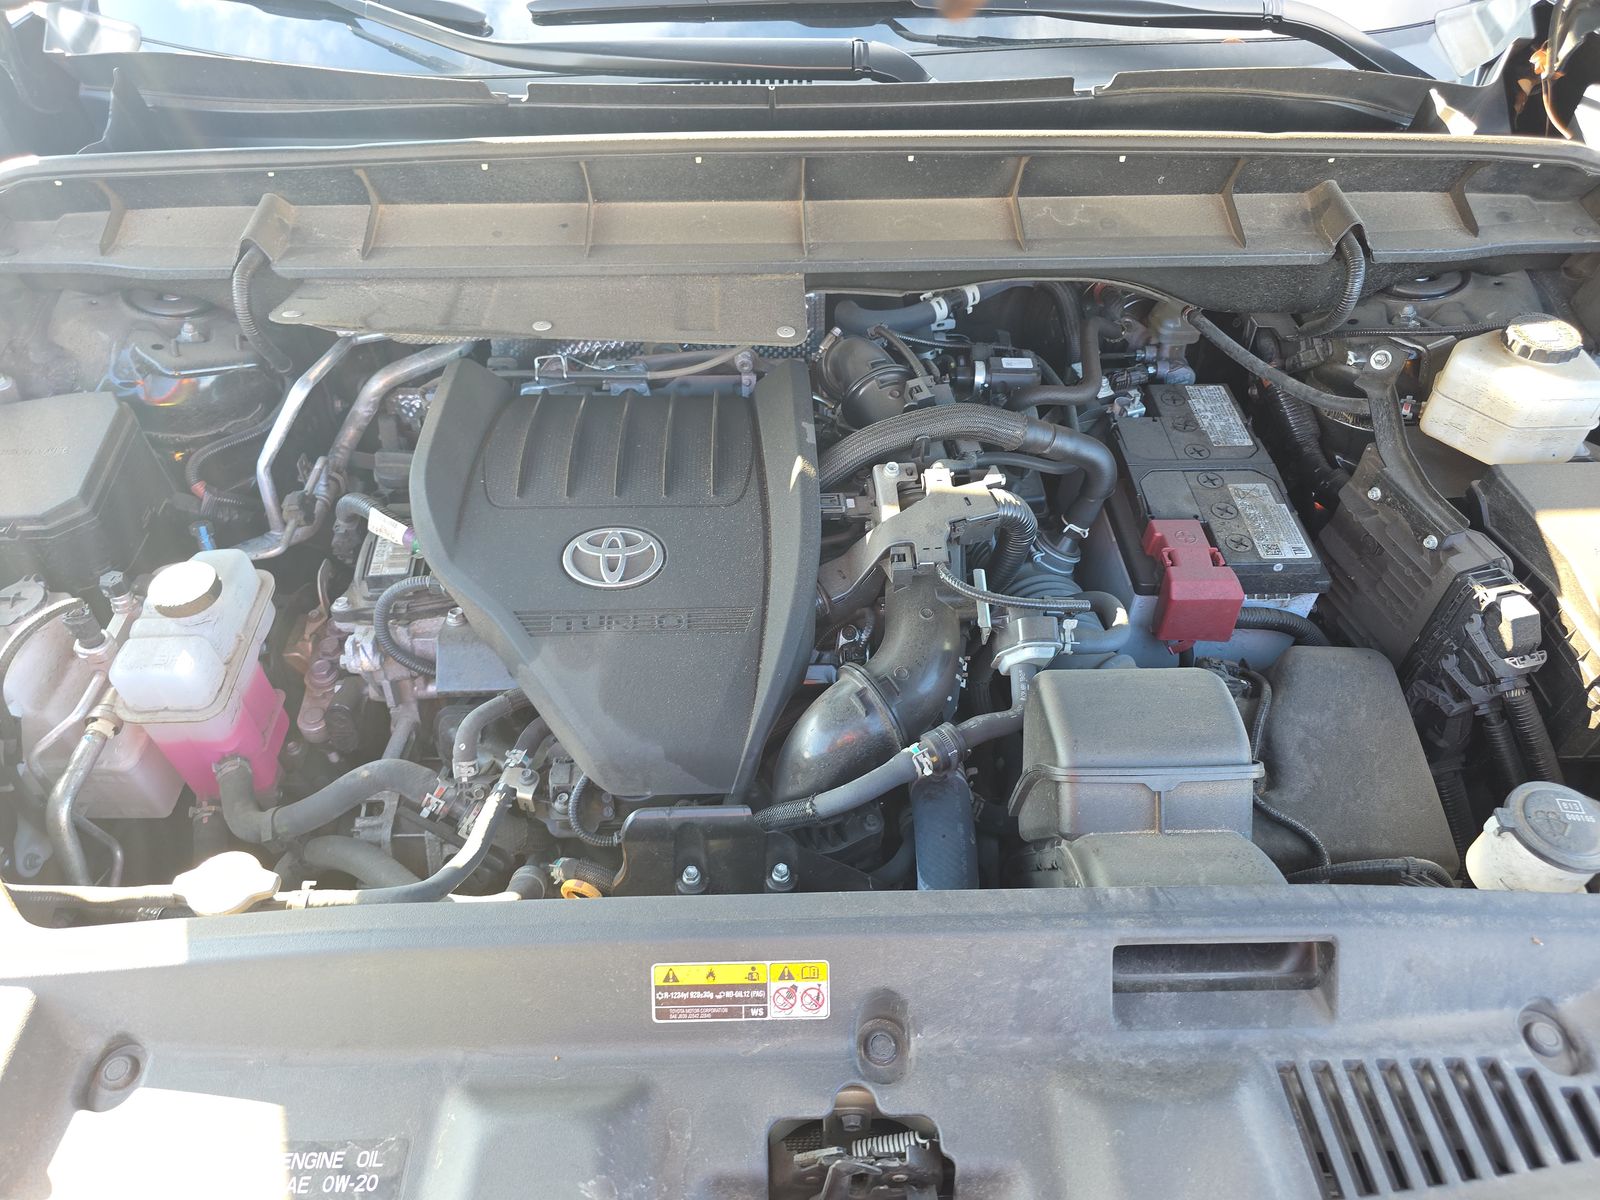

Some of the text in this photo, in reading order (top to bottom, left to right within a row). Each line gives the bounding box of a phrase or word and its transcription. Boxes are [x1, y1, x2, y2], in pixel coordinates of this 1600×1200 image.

[751, 1007, 764, 1017] WS
[283, 1150, 384, 1170] ENGINE OIL
[286, 1174, 379, 1194] AE 0W-20
